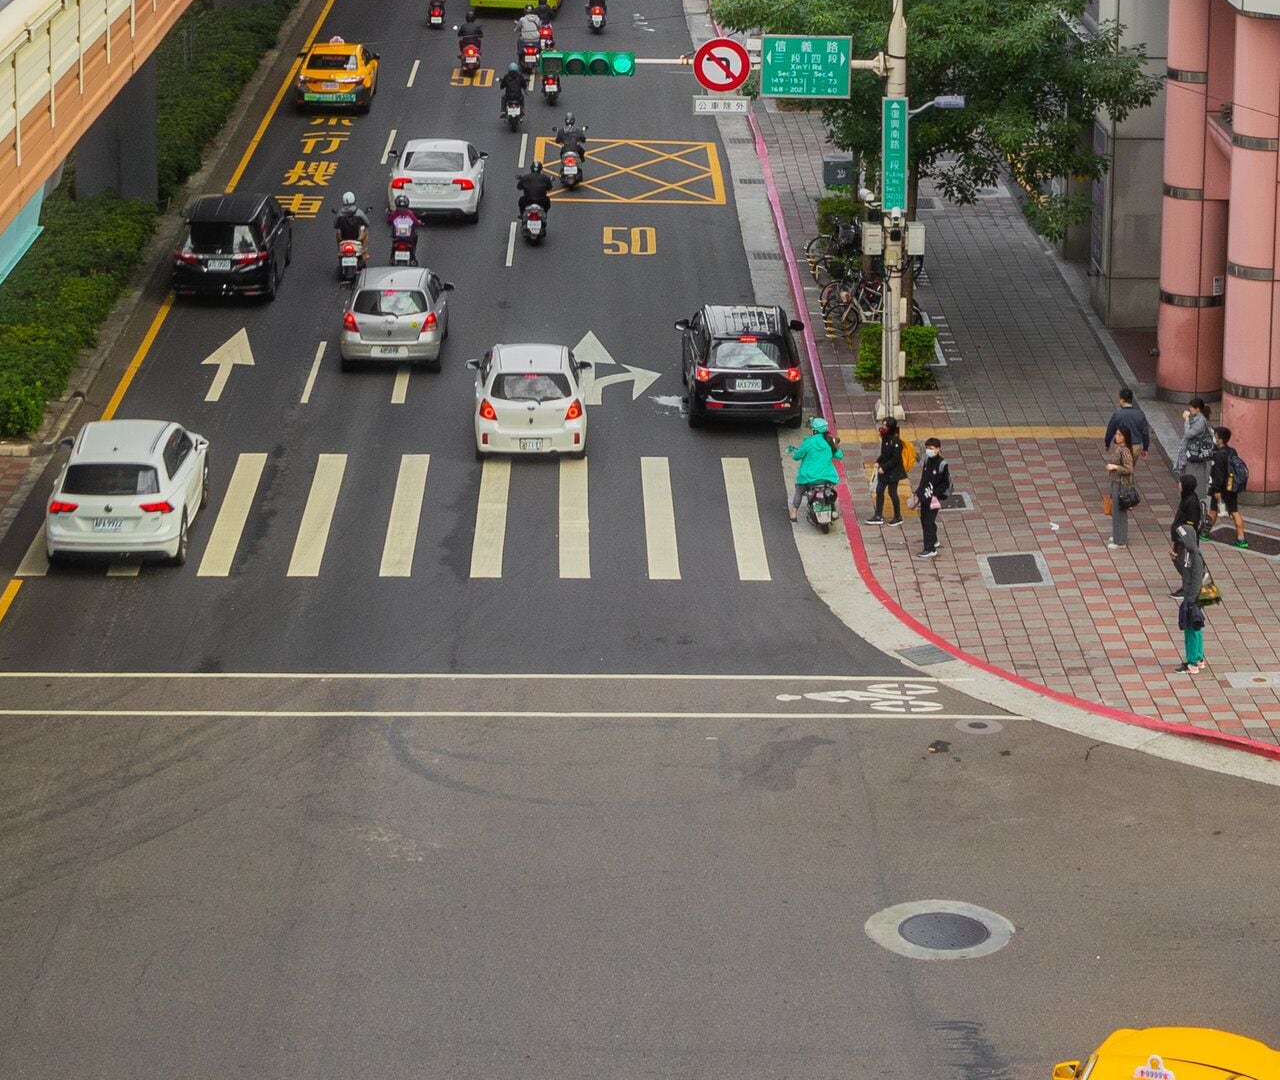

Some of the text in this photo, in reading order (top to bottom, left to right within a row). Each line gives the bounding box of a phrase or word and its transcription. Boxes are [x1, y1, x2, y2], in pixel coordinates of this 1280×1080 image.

[775, 40, 838, 53] 信義路
[450, 68, 495, 87] 50
[698, 101, 745, 111] 公車除外
[602, 226, 658, 256] 50
